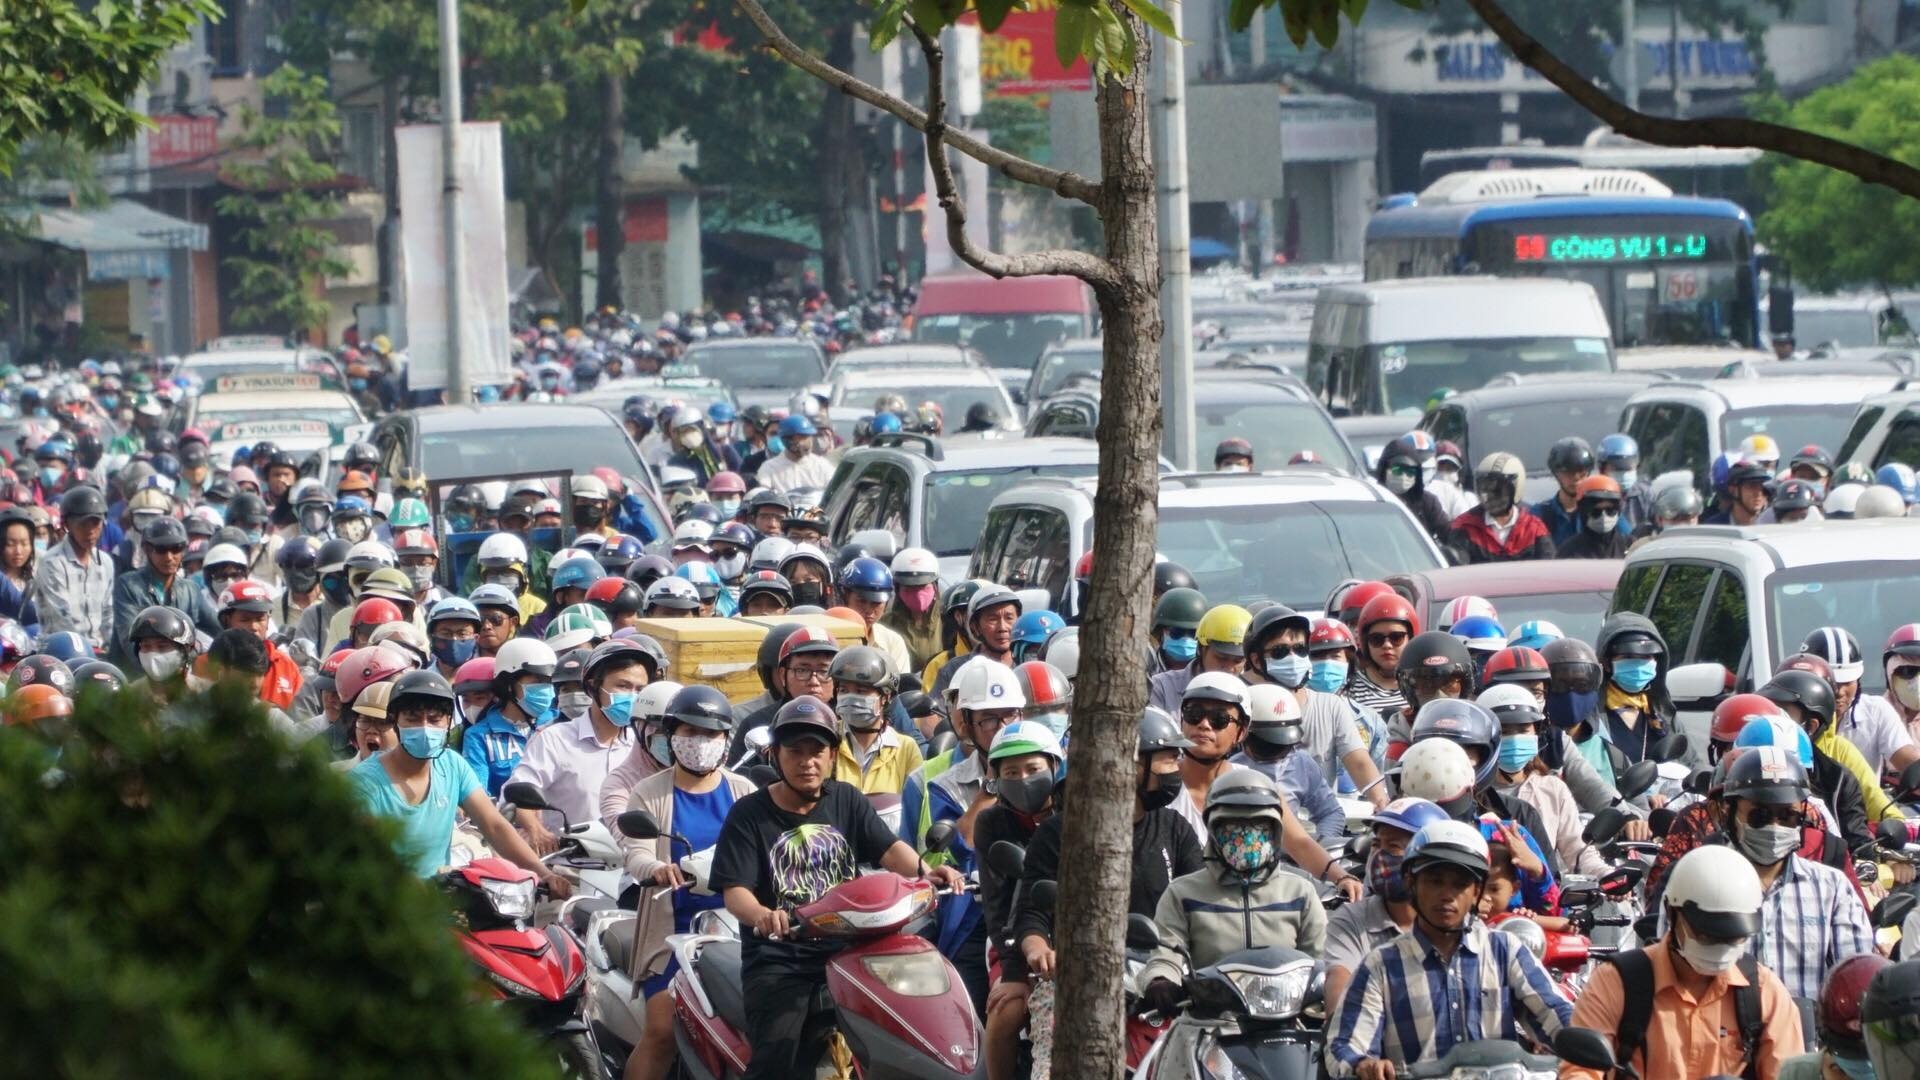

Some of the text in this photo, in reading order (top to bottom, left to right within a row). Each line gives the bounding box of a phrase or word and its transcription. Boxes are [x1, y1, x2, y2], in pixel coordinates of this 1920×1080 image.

[1551, 235, 1616, 260] CÔNG
[1656, 236, 1667, 257] 1
[244, 377, 294, 386] VINASUN
[249, 424, 301, 433] VINASUN
